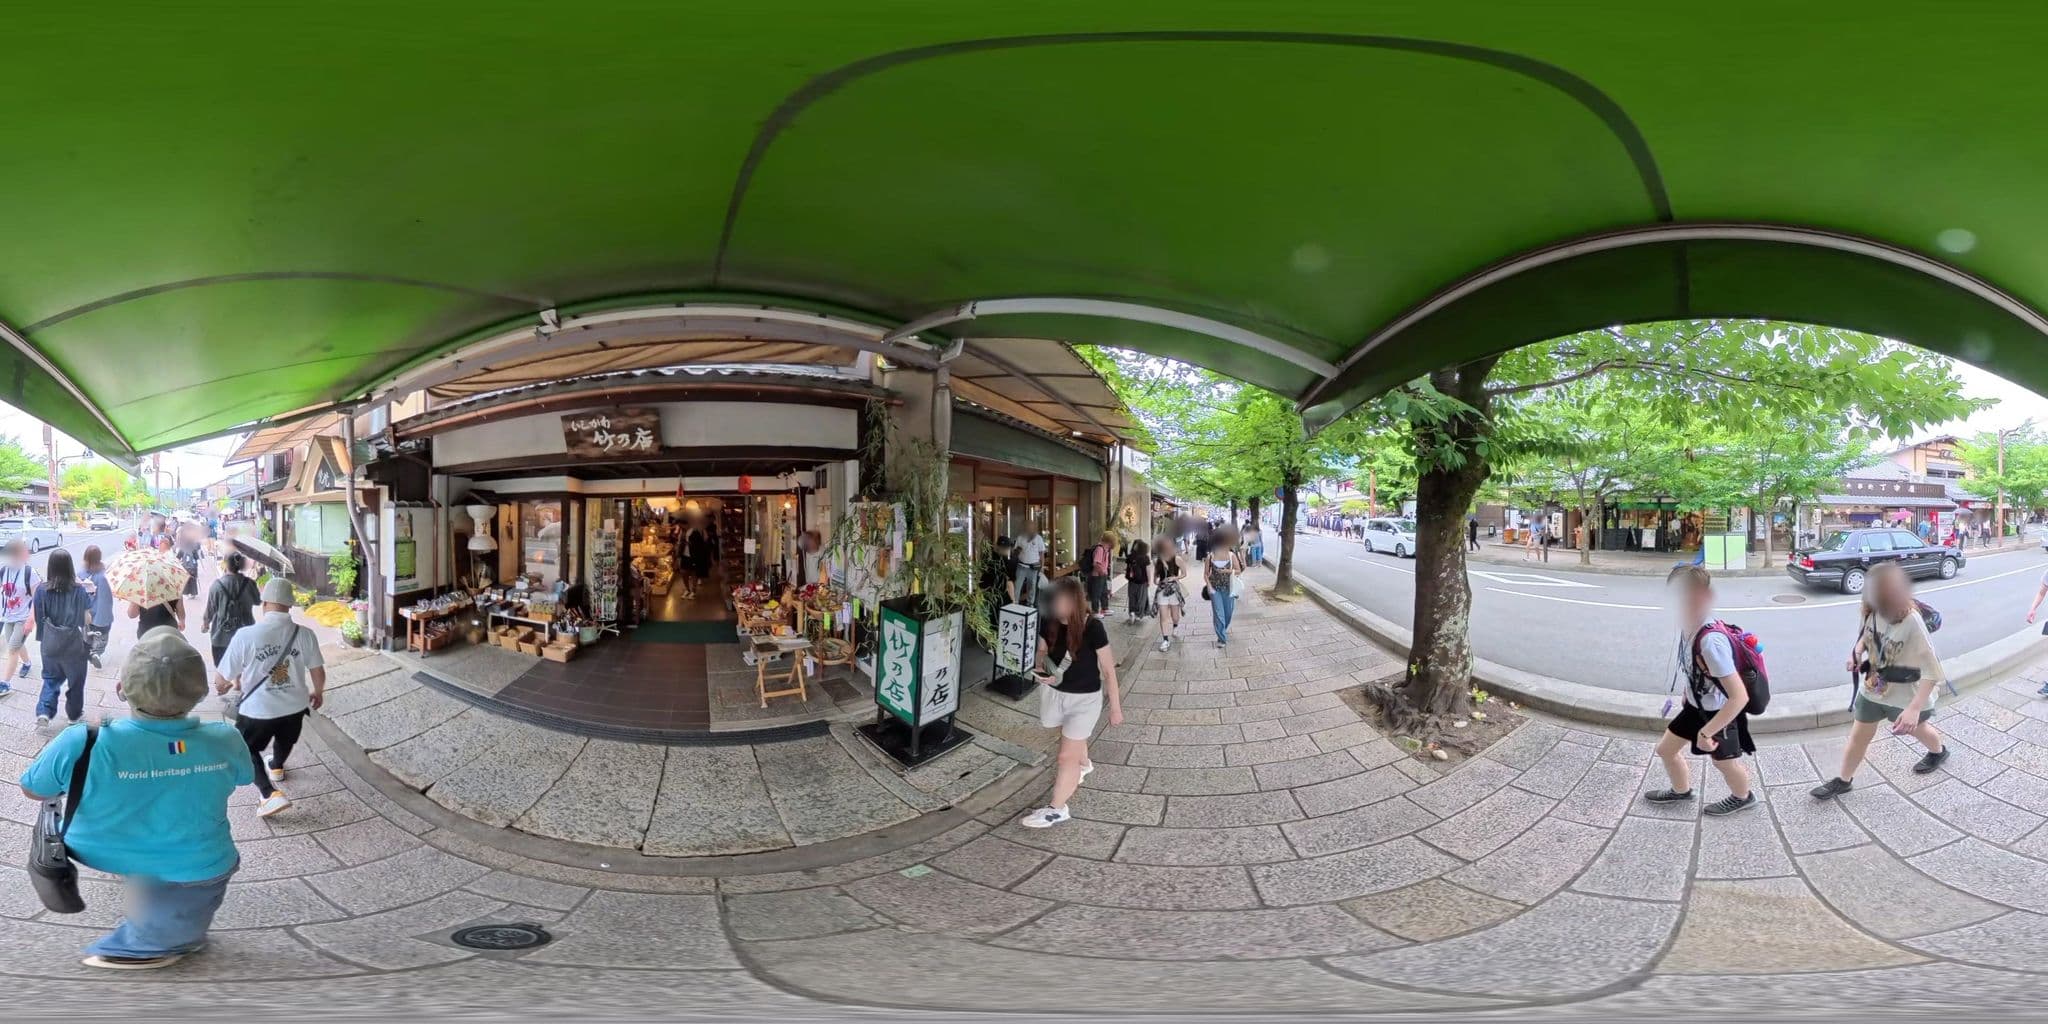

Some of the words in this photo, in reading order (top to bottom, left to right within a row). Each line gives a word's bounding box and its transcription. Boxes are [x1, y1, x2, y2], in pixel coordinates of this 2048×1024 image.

[571, 416, 610, 431] いしかわ
[593, 428, 653, 452] 竹乃店
[885, 629, 910, 702] 竹乃店
[118, 770, 148, 780] World
[151, 767, 191, 778] Heritage
